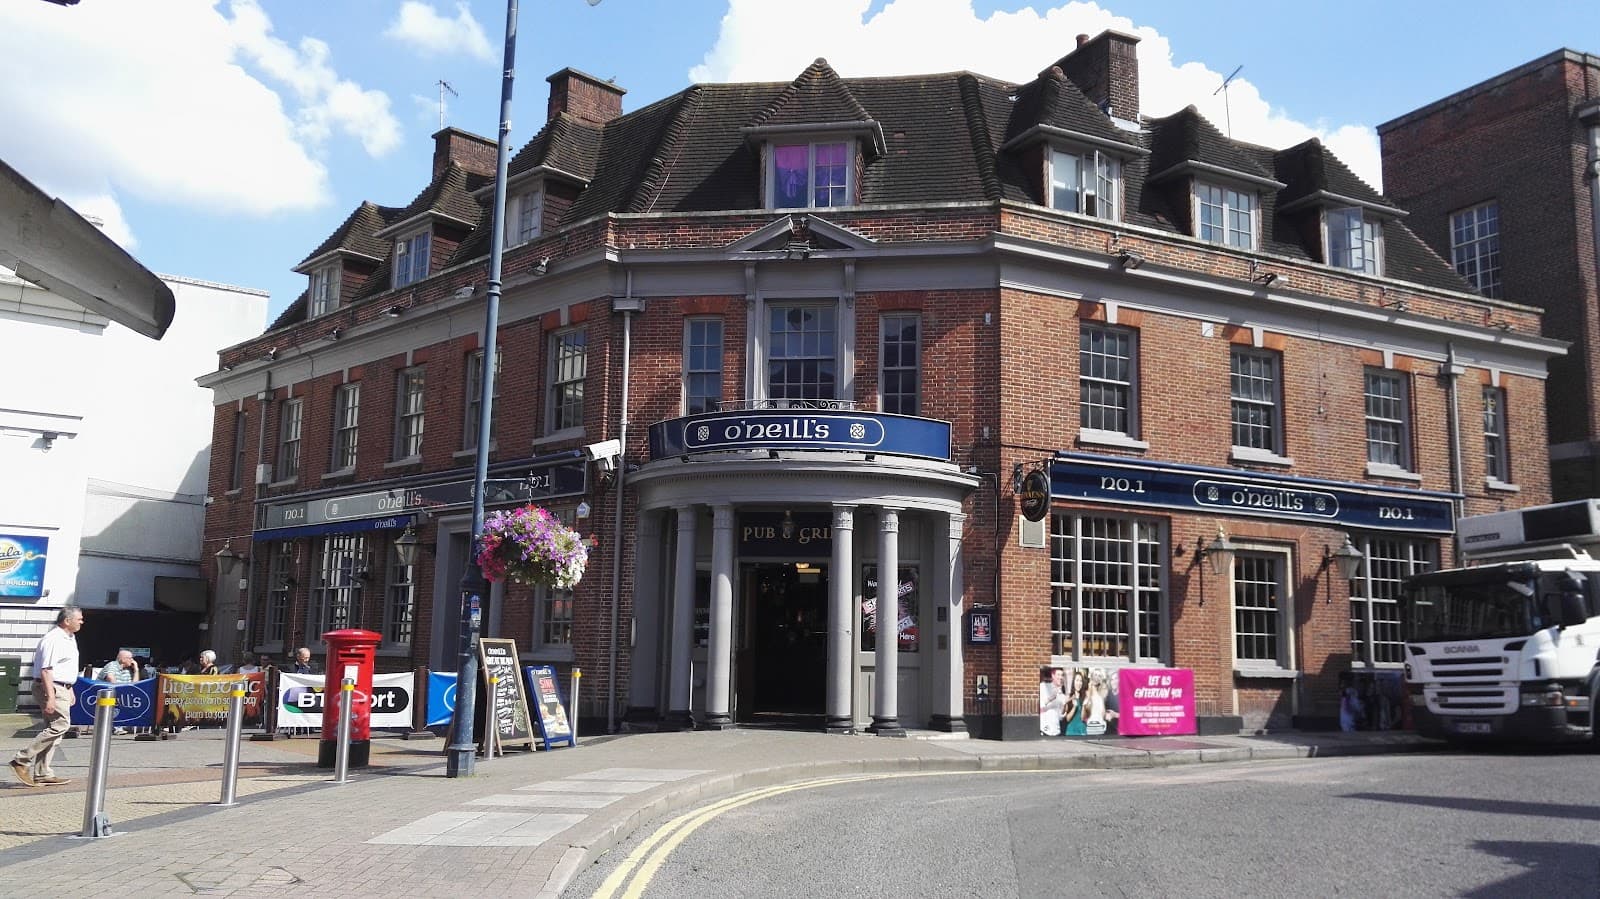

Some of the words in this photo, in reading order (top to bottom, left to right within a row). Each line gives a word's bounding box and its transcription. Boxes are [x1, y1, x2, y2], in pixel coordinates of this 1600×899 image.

[1100, 475, 1145, 493] no.1
[1379, 505, 1414, 520] no.1
[743, 526, 776, 541] PUB
[1443, 645, 1480, 654] SCANIA
[200, 676, 260, 694] muic
